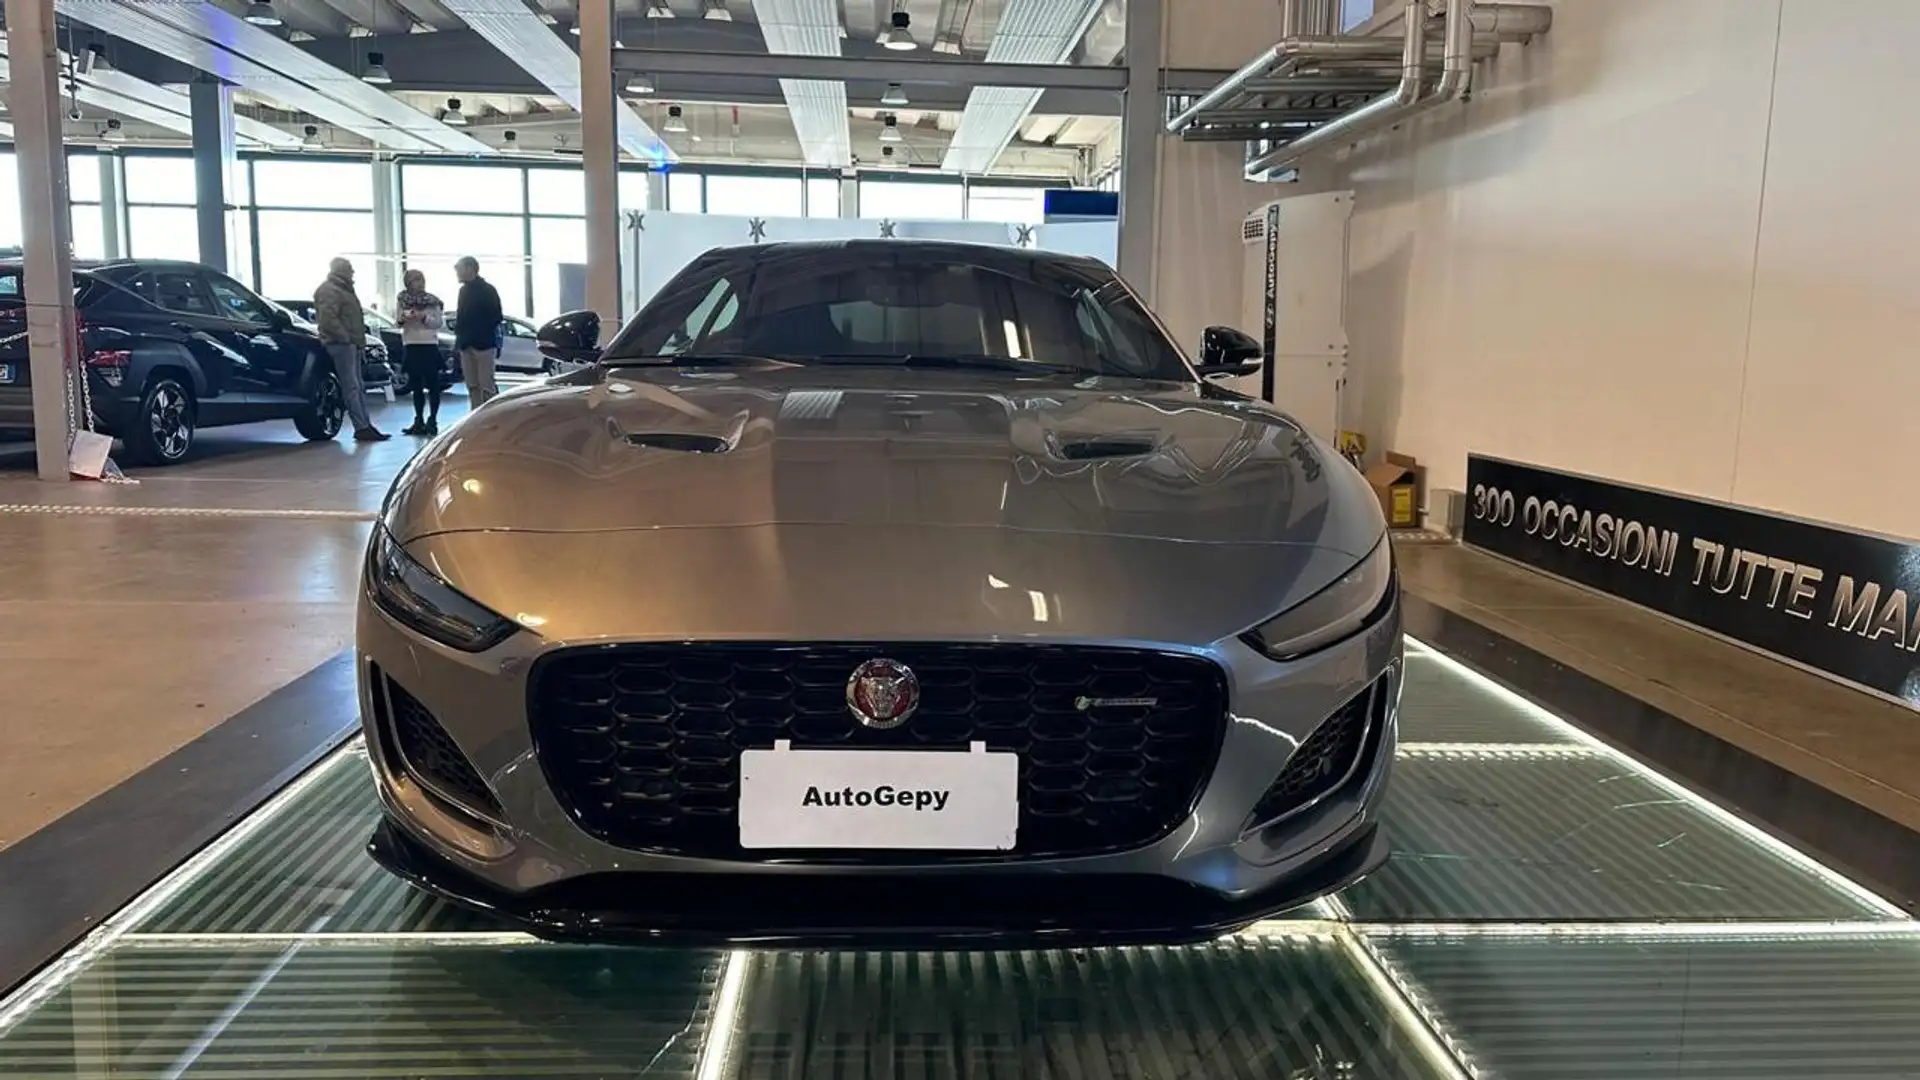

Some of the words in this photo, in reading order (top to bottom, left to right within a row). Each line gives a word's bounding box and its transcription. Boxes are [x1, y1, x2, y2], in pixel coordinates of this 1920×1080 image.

[1473, 483, 1515, 527] 300
[1523, 495, 1679, 577] OCCASIONI
[1692, 537, 1824, 620] TUTTE
[802, 785, 949, 811] AutoGepy
